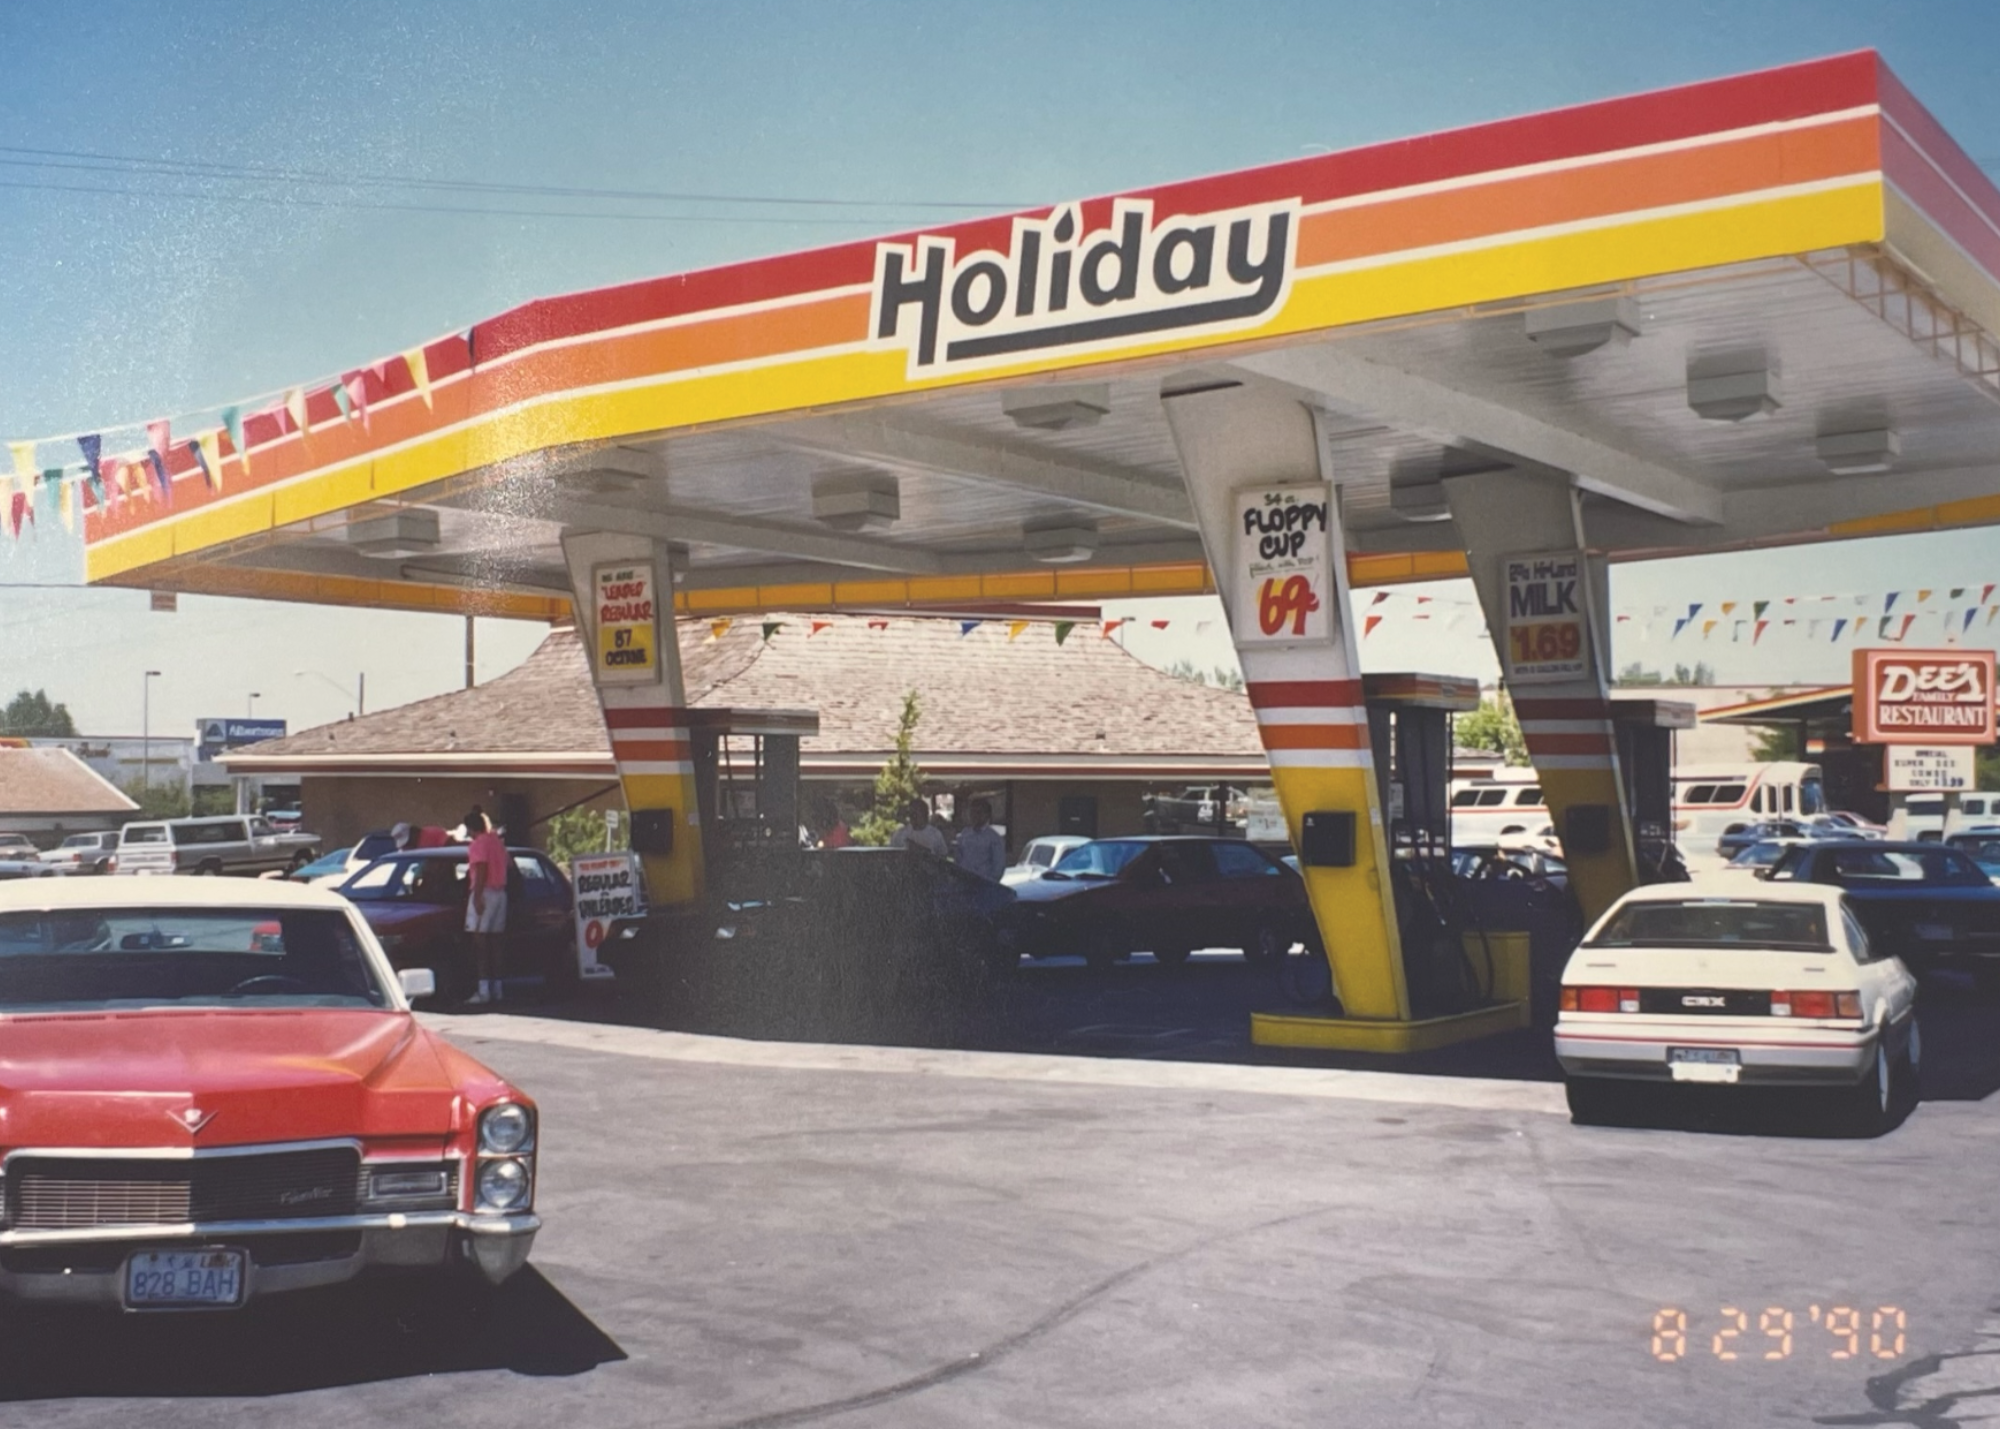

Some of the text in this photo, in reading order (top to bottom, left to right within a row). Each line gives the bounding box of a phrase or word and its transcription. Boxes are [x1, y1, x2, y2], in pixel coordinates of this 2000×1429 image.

[877, 207, 1291, 367] Holiday
[1244, 502, 1327, 535] FLOPPY
[1259, 531, 1306, 560] CUP
[1510, 580, 1578, 618] MILK
[601, 601, 654, 623] REGULAR
[615, 629, 632, 648] 87
[605, 649, 647, 666] OCTANE
[1880, 705, 1987, 726] RESTAURANT
[578, 870, 632, 894] REGULAR
[1681, 996, 1726, 1008] CRX
[134, 1270, 234, 1298] 828 BAH
